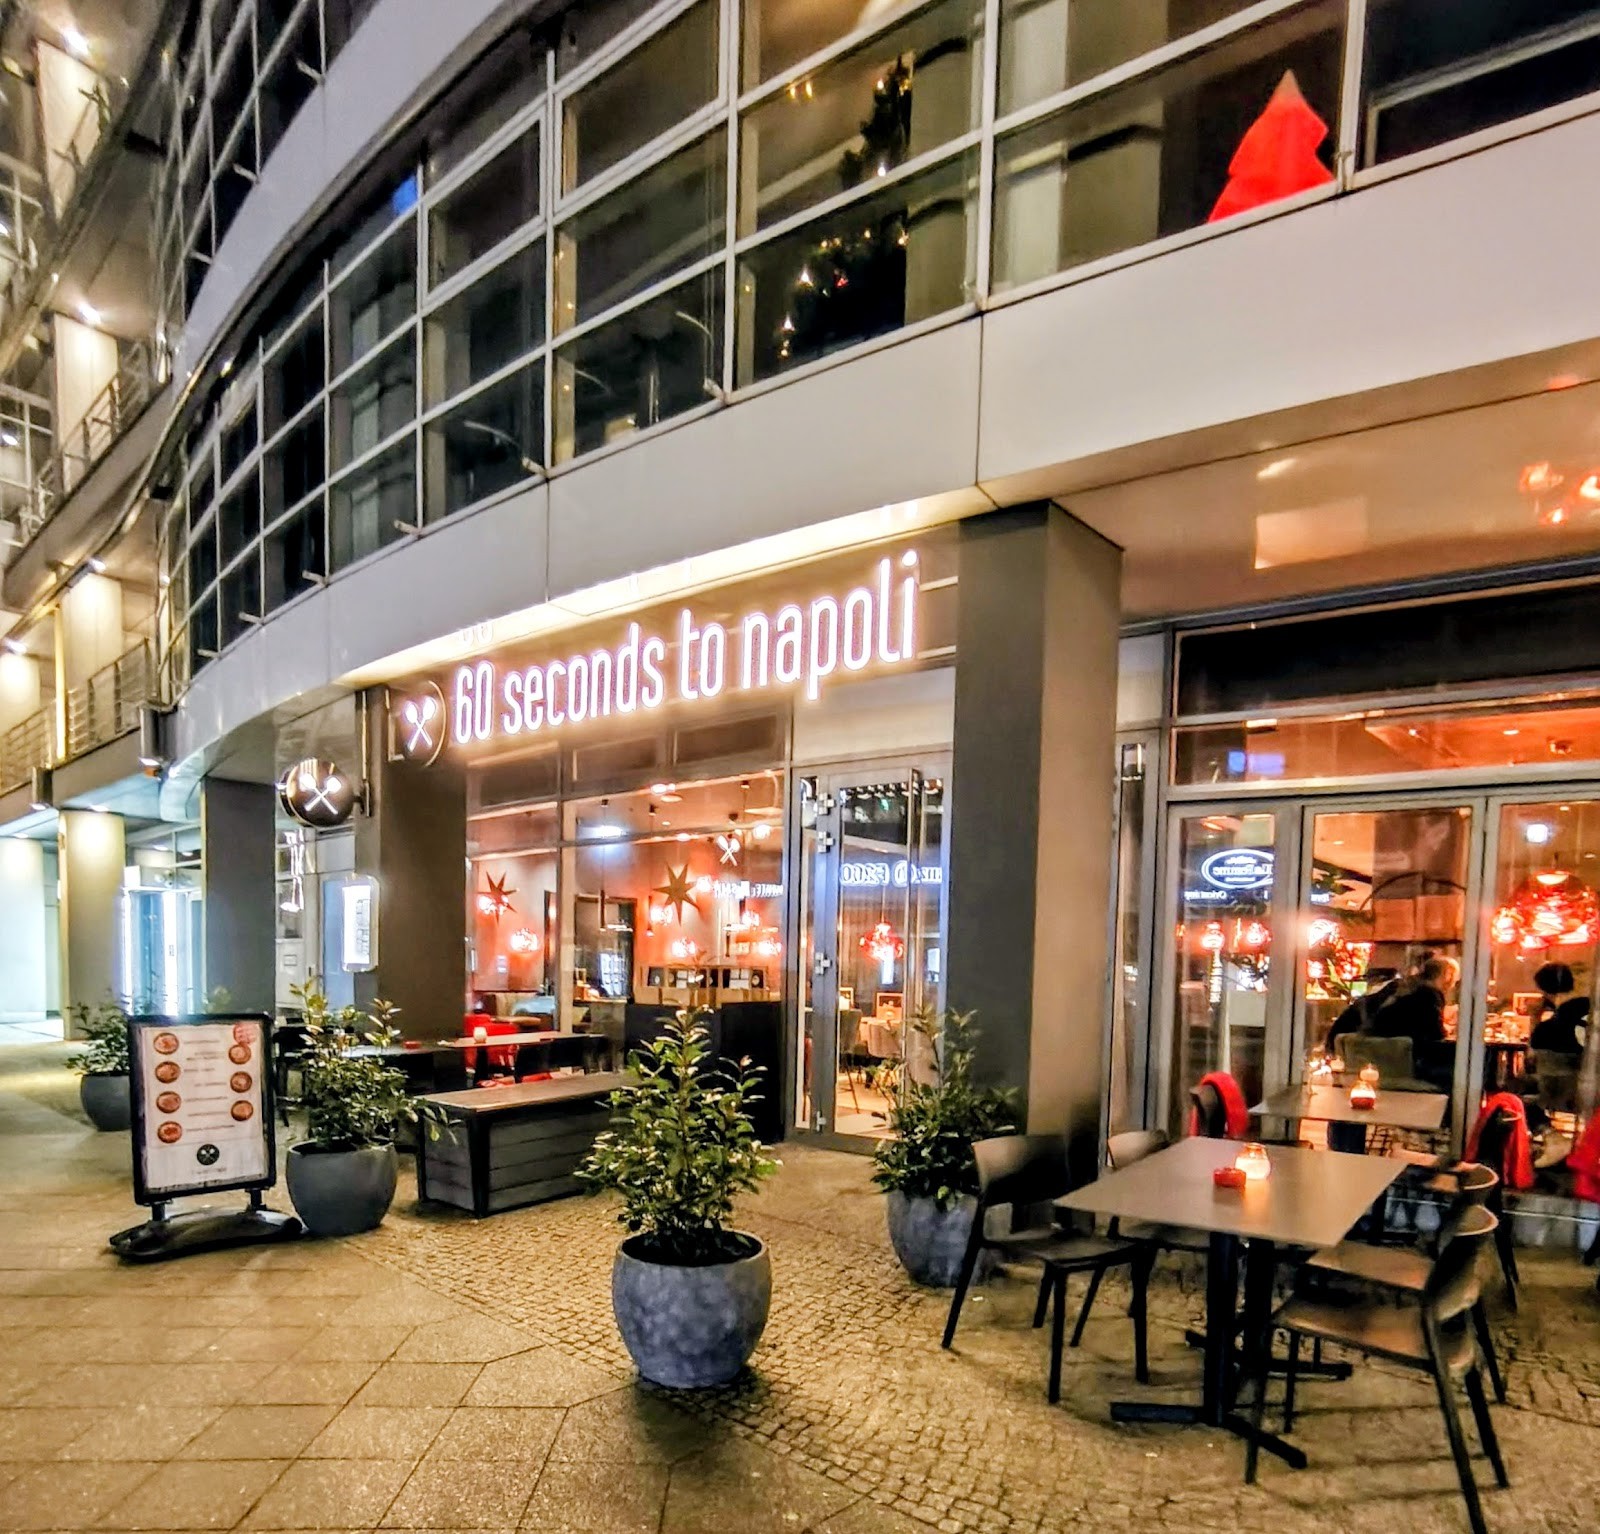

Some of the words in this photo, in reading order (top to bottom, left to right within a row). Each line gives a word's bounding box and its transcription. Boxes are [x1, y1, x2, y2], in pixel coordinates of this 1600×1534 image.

[455, 661, 493, 744] 60
[503, 622, 665, 735] seconds
[680, 608, 725, 699] to
[741, 550, 918, 700] napoli
